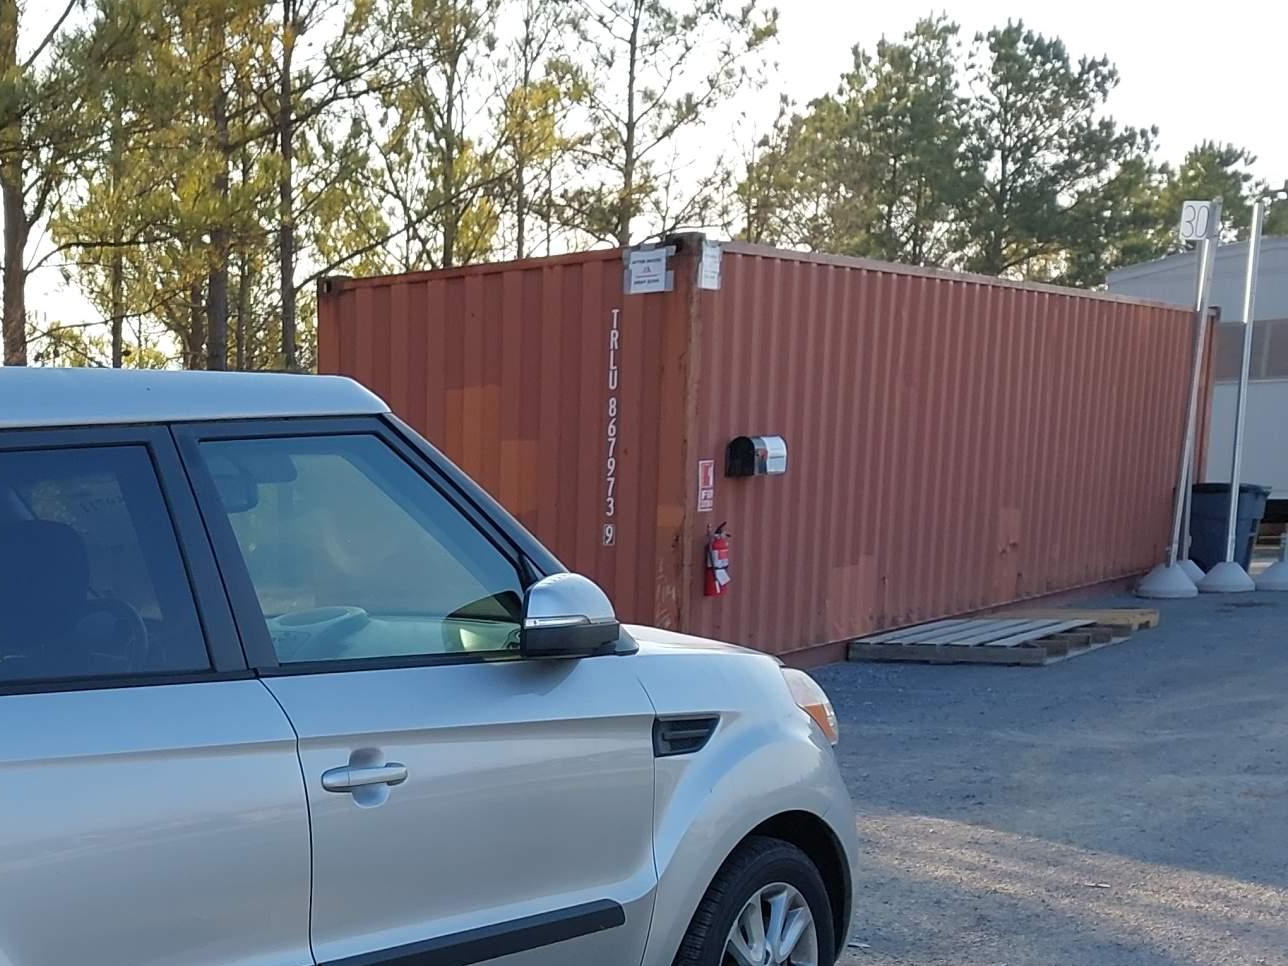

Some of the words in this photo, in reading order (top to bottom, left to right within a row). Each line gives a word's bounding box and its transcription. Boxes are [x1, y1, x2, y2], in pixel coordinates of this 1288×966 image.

[1182, 204, 1210, 238] 30
[609, 308, 620, 390] TRLU
[606, 397, 617, 516] 867973
[605, 525, 614, 544] 9
